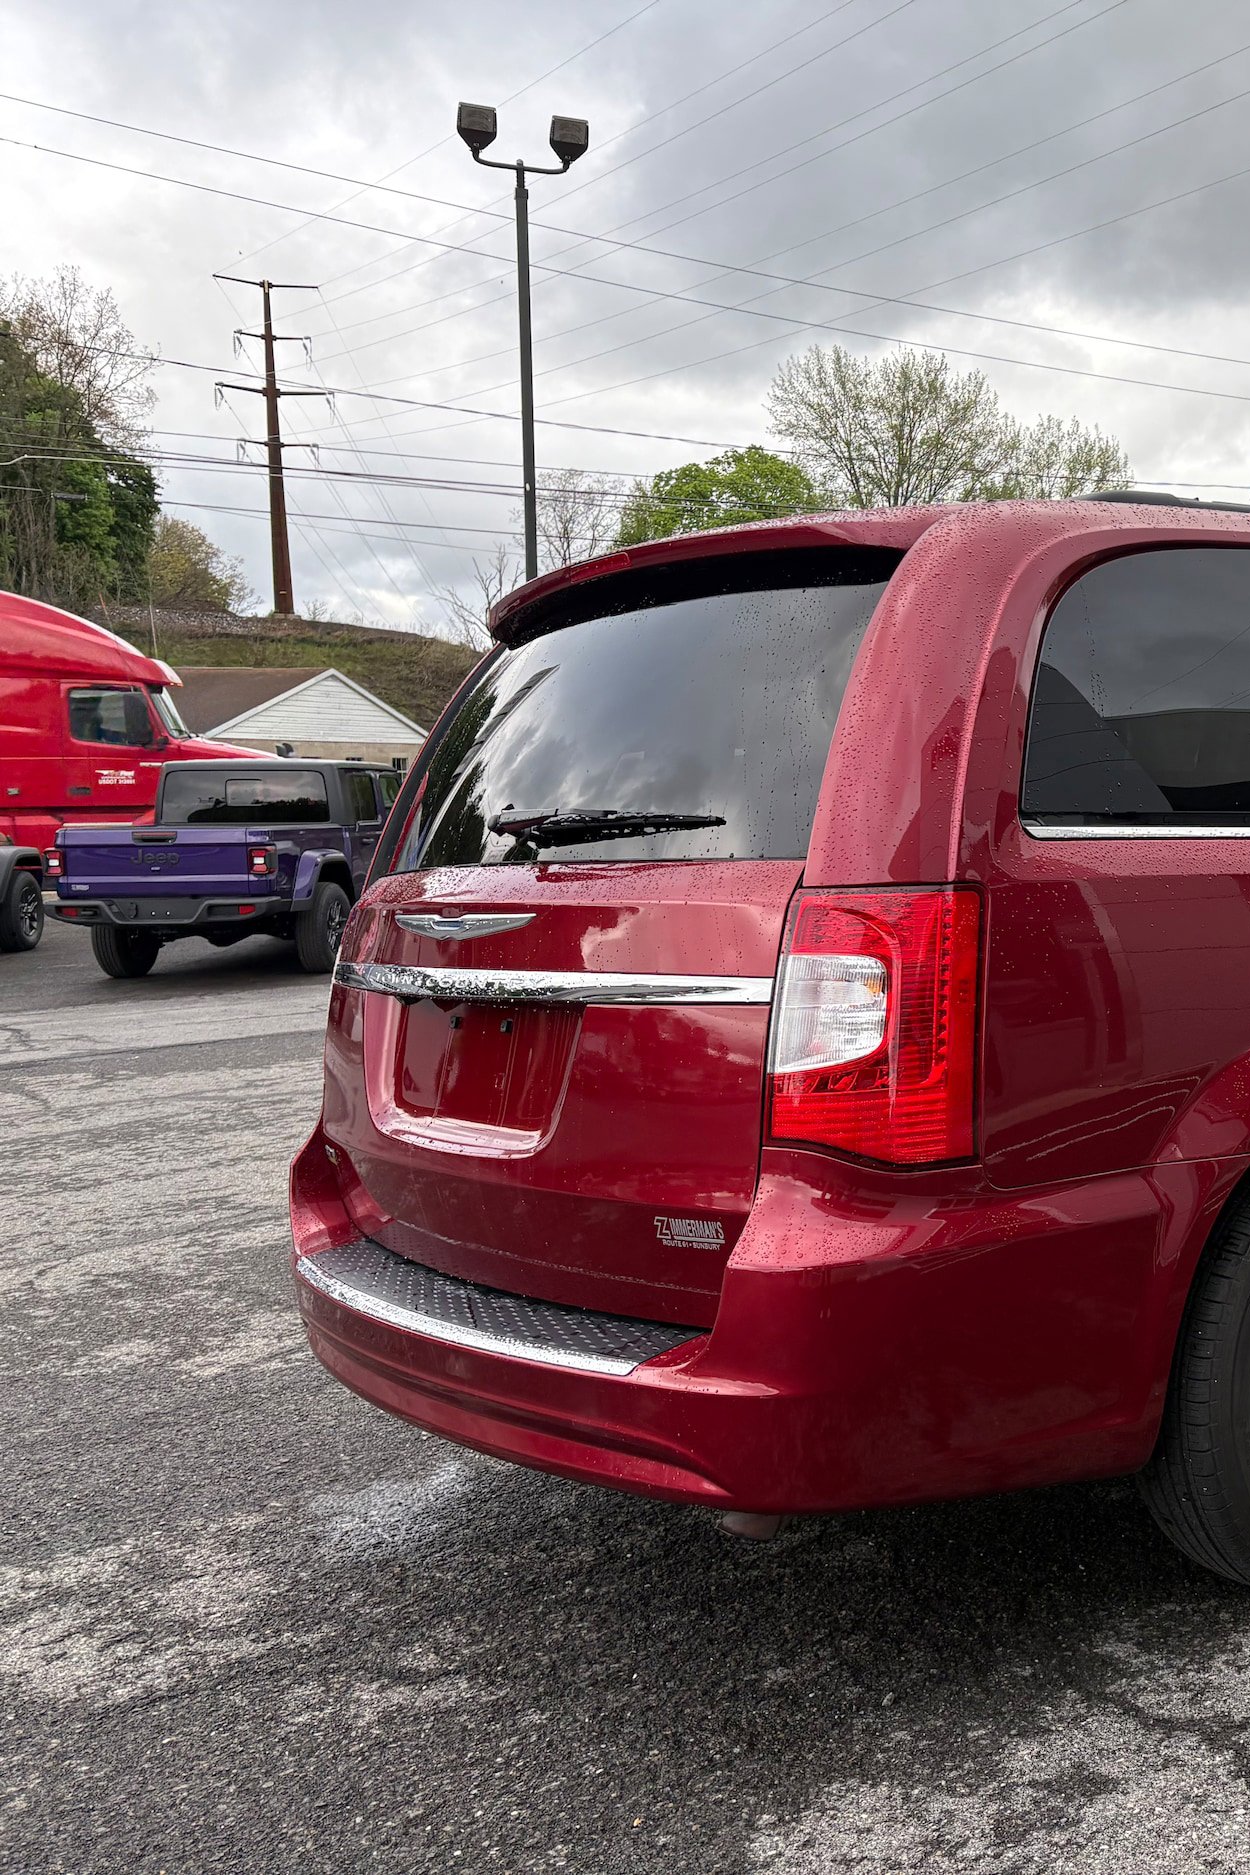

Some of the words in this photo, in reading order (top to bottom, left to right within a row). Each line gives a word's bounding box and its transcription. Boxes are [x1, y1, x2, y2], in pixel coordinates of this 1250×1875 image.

[131, 849, 180, 865] Jeep
[375, 971, 413, 985] TOWN
[426, 976, 545, 989] COUNTRY
[653, 1216, 725, 1240] ZIMMERMAN'S
[662, 1239, 682, 1248] ROUTE
[693, 1242, 721, 1251] SUNBURY
